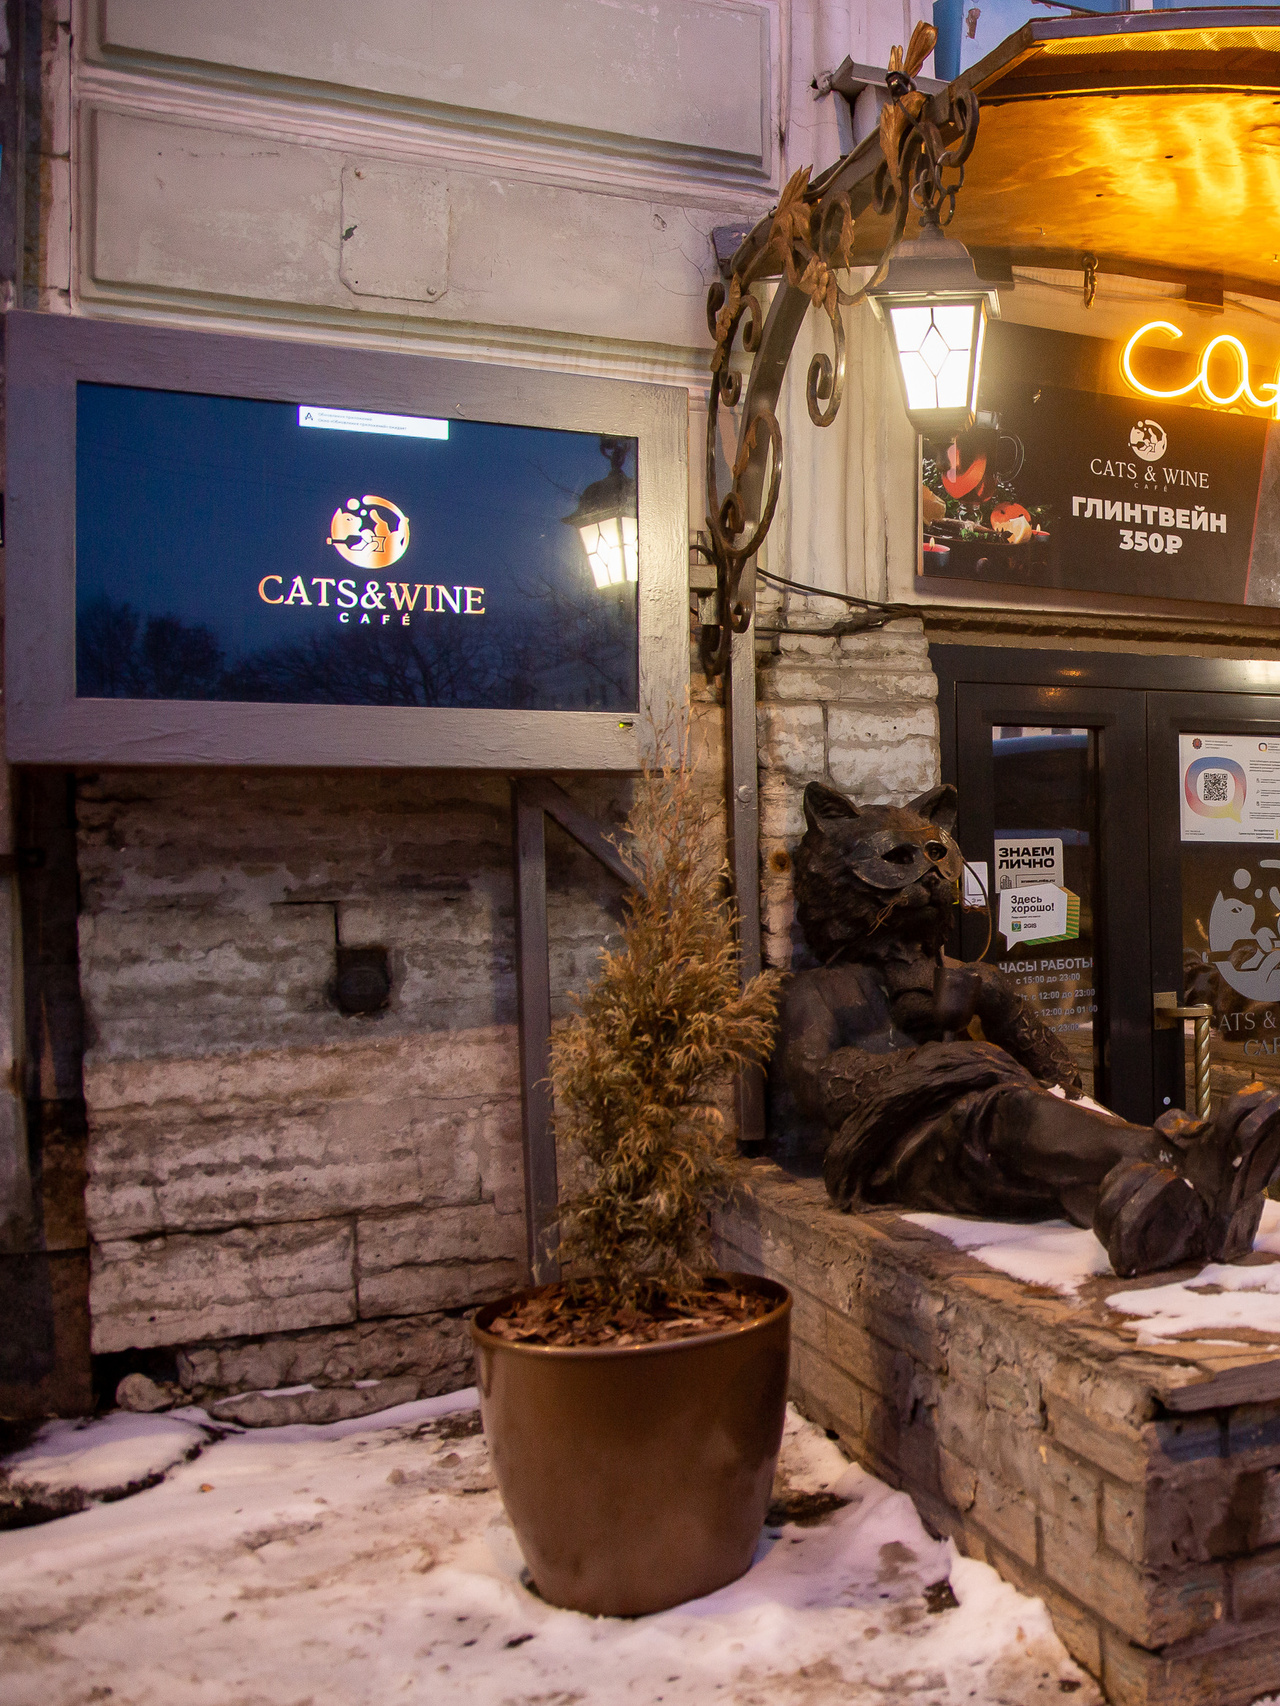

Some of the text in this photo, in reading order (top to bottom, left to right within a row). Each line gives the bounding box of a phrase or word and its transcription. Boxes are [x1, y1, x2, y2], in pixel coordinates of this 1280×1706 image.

[1090, 458, 1210, 489] CATS & WINE
[1072, 495, 1227, 534] ГЛИНТВЕЙН
[338, 612, 411, 626] CAFÉ
[999, 846, 1054, 858] ЗНАЕМ
[999, 858, 1055, 869] ЛИЧНО
[1011, 895, 1042, 905] Здесь
[1011, 903, 1055, 914] хорошо!
[999, 957, 1093, 973] ЧАСЫ РАБОТЫ
[1023, 975, 1045, 984] 15:00
[1059, 973, 1081, 982] 23:00
[1039, 991, 1060, 1000] 12:00
[1074, 988, 1095, 998] 23:00
[1041, 1008, 1062, 1016] 12:00
[1064, 1008, 1074, 1016] до
[1076, 1005, 1098, 1014] 0100
[1263, 1010, 1277, 1029] &
[1059, 1023, 1080, 1032] 23:00
